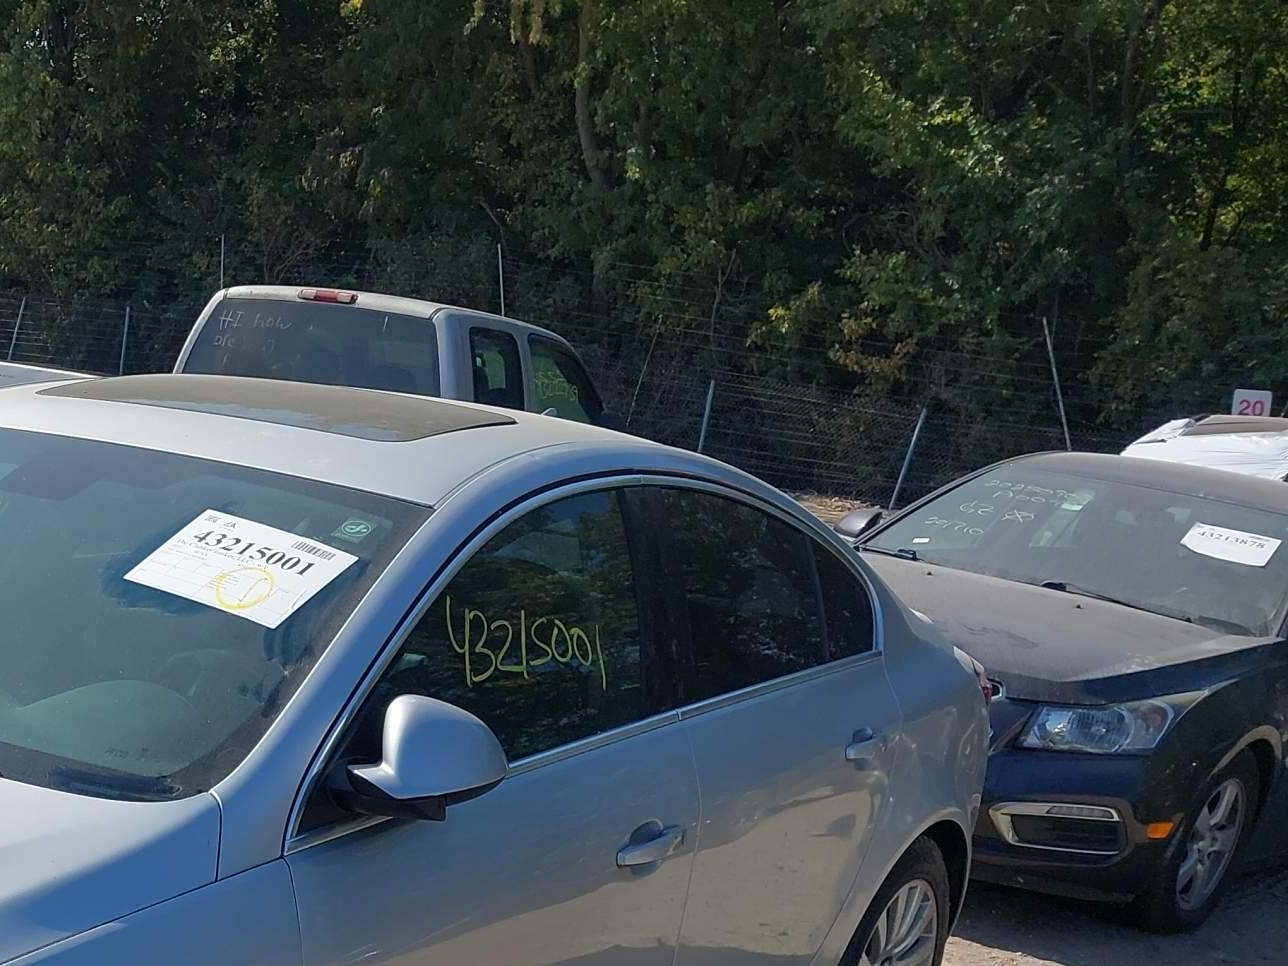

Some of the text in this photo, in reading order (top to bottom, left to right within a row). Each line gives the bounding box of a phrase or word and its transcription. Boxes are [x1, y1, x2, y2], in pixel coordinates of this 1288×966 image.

[1238, 400, 1265, 417] 20
[193, 529, 316, 577] 43215001
[446, 595, 607, 691] 43215001
